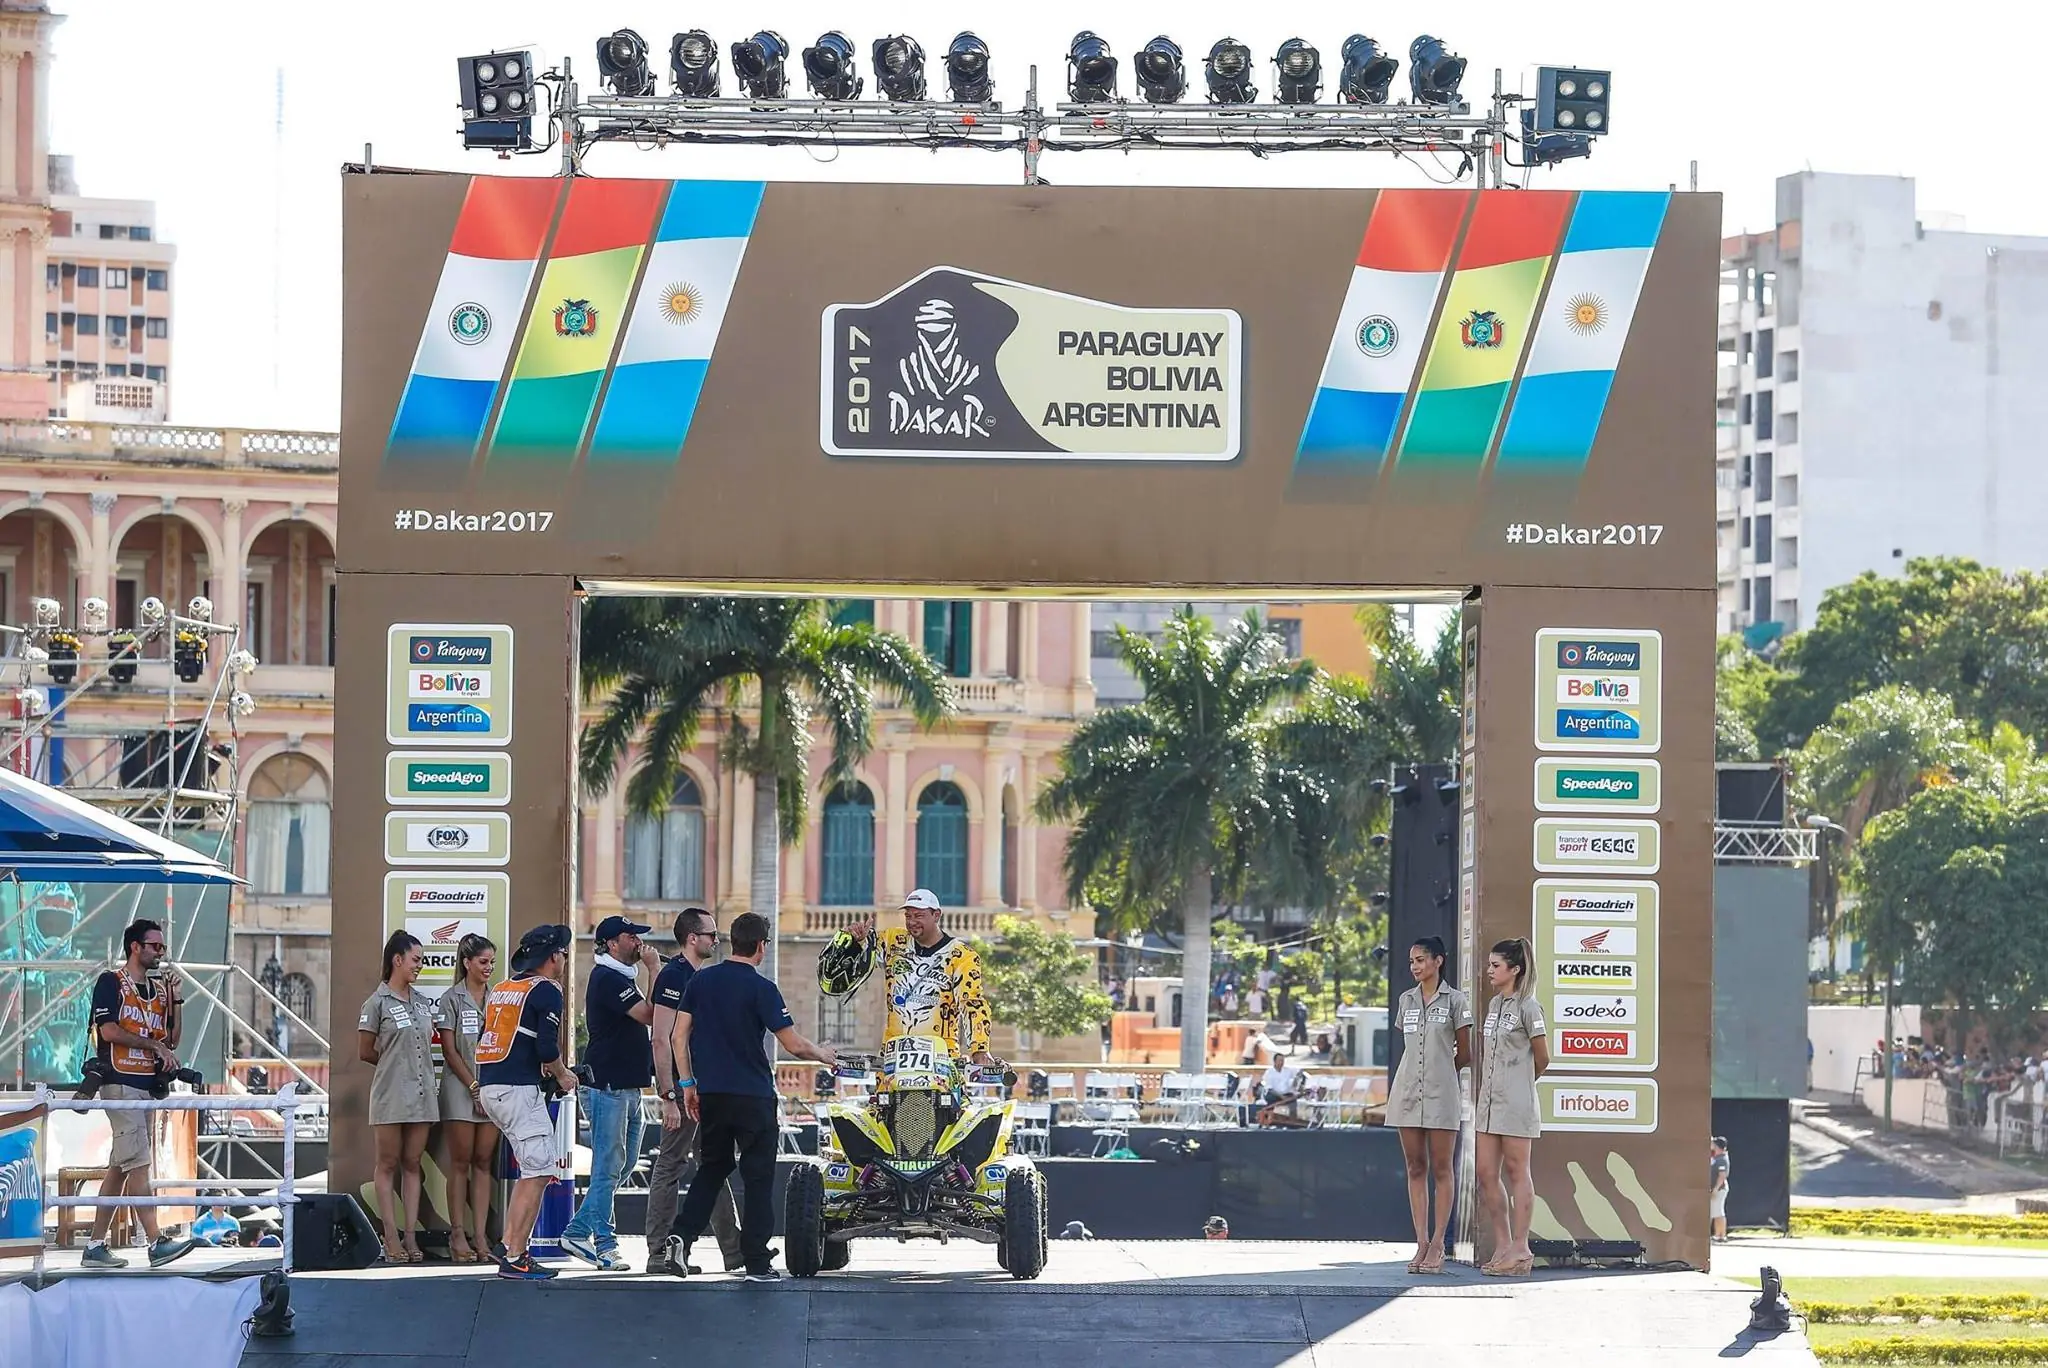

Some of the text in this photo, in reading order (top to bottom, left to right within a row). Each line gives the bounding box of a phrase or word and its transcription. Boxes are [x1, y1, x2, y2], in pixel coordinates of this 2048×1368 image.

[1058, 331, 1224, 357] PARAGUAY
[848, 325, 871, 433] 2017
[1107, 366, 1223, 392] BOLIVIA
[889, 390, 990, 439] DAKAR
[1042, 402, 1221, 429] ARGENTINA
[394, 509, 554, 532] #Dakar2017
[1506, 523, 1664, 545] #Dakar2017
[436, 640, 487, 662] Paraguay
[1585, 645, 1636, 668] Paraguay
[419, 673, 481, 691] Bolivia
[1567, 679, 1629, 697] Bolivia
[416, 710, 483, 725] Argentina
[1564, 715, 1632, 732] Argentina
[413, 771, 484, 785] SpeedAgro
[1561, 777, 1633, 792] SpeedAgro
[435, 830, 460, 841] FOX
[1559, 843, 1588, 853] sport
[409, 891, 485, 901] BFGoodrich
[1558, 898, 1635, 910] BFGoodrich
[1563, 1004, 1627, 1018] sodexo
[1565, 1036, 1625, 1050] TOYOTA
[898, 1052, 930, 1069] 274
[1560, 1094, 1630, 1112] infobae
